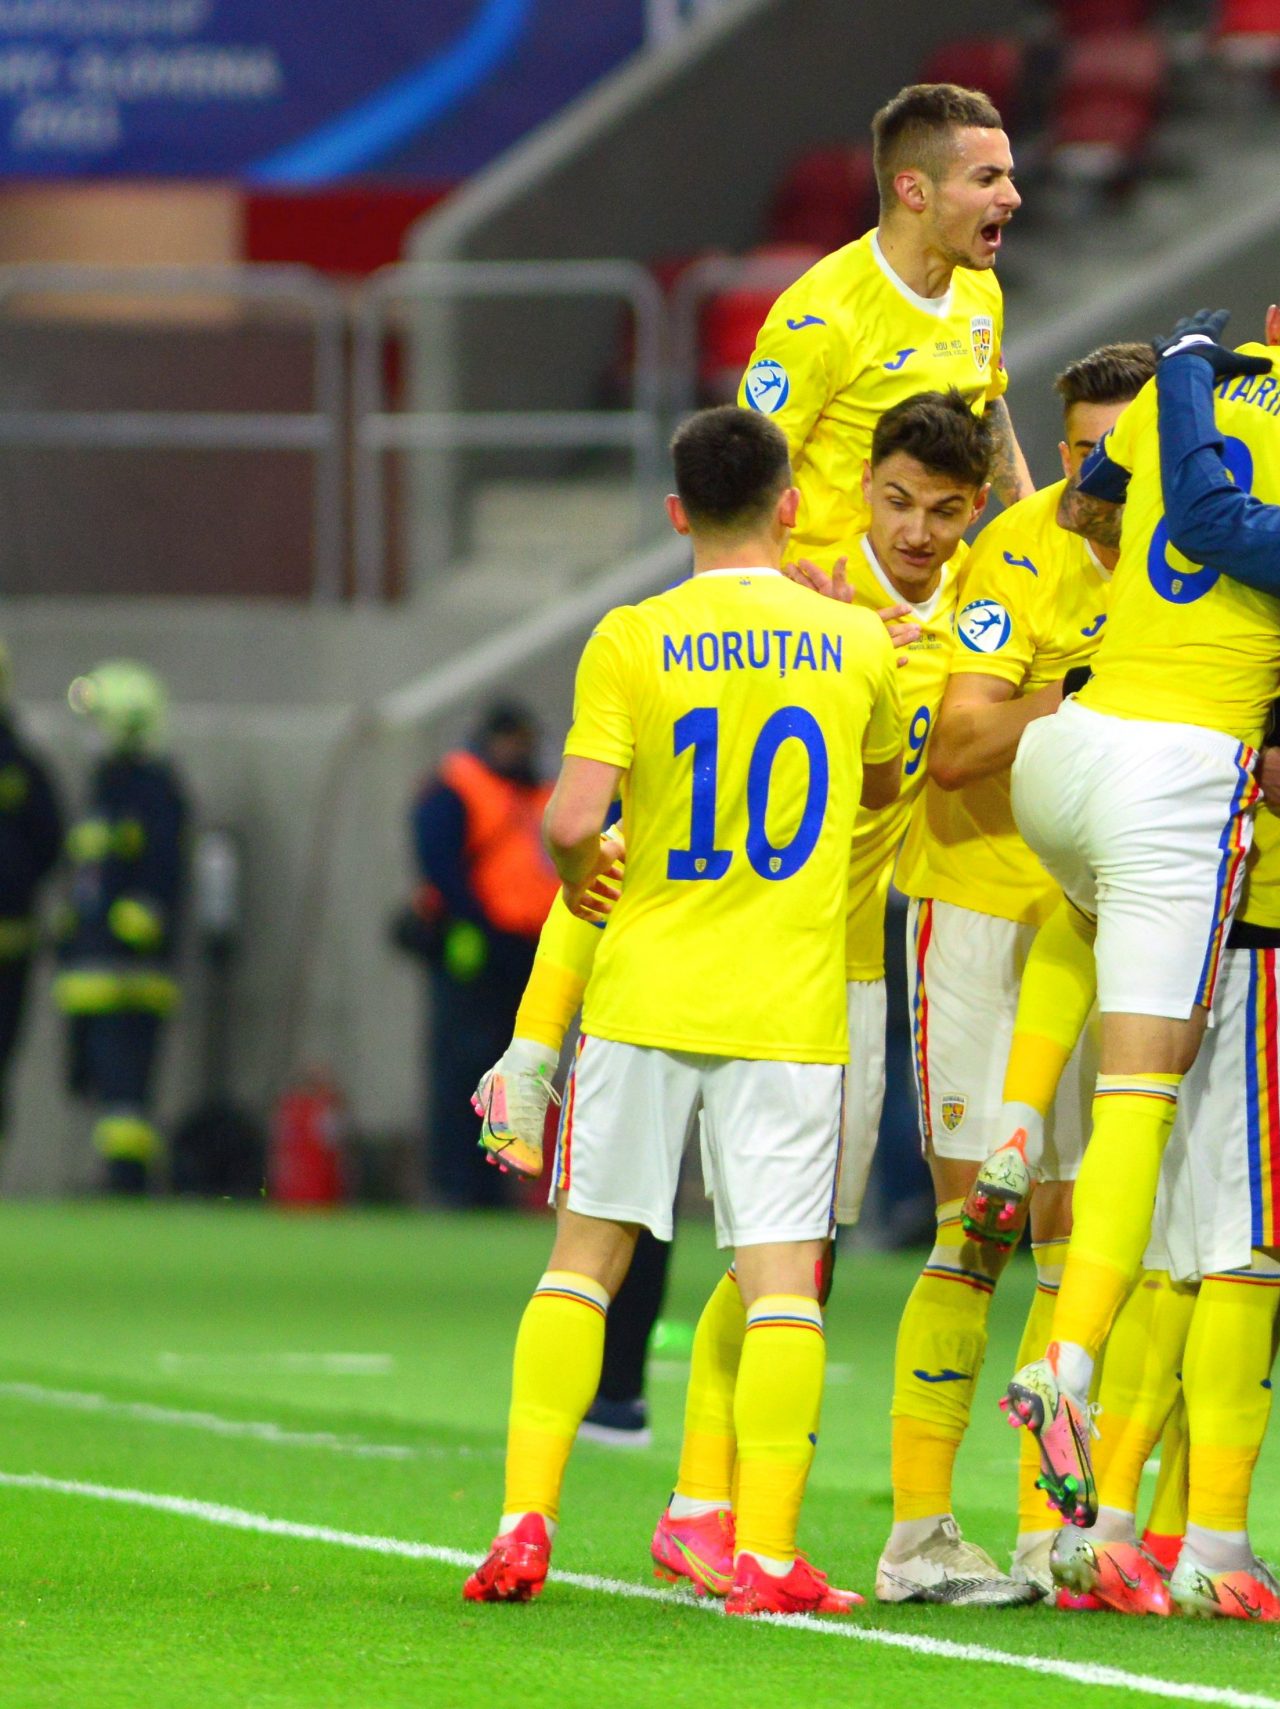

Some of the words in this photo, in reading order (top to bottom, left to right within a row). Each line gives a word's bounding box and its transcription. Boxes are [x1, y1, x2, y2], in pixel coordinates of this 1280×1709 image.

[663, 630, 842, 678] MORUȚAN
[903, 705, 931, 776] 9
[667, 706, 828, 881] 10
